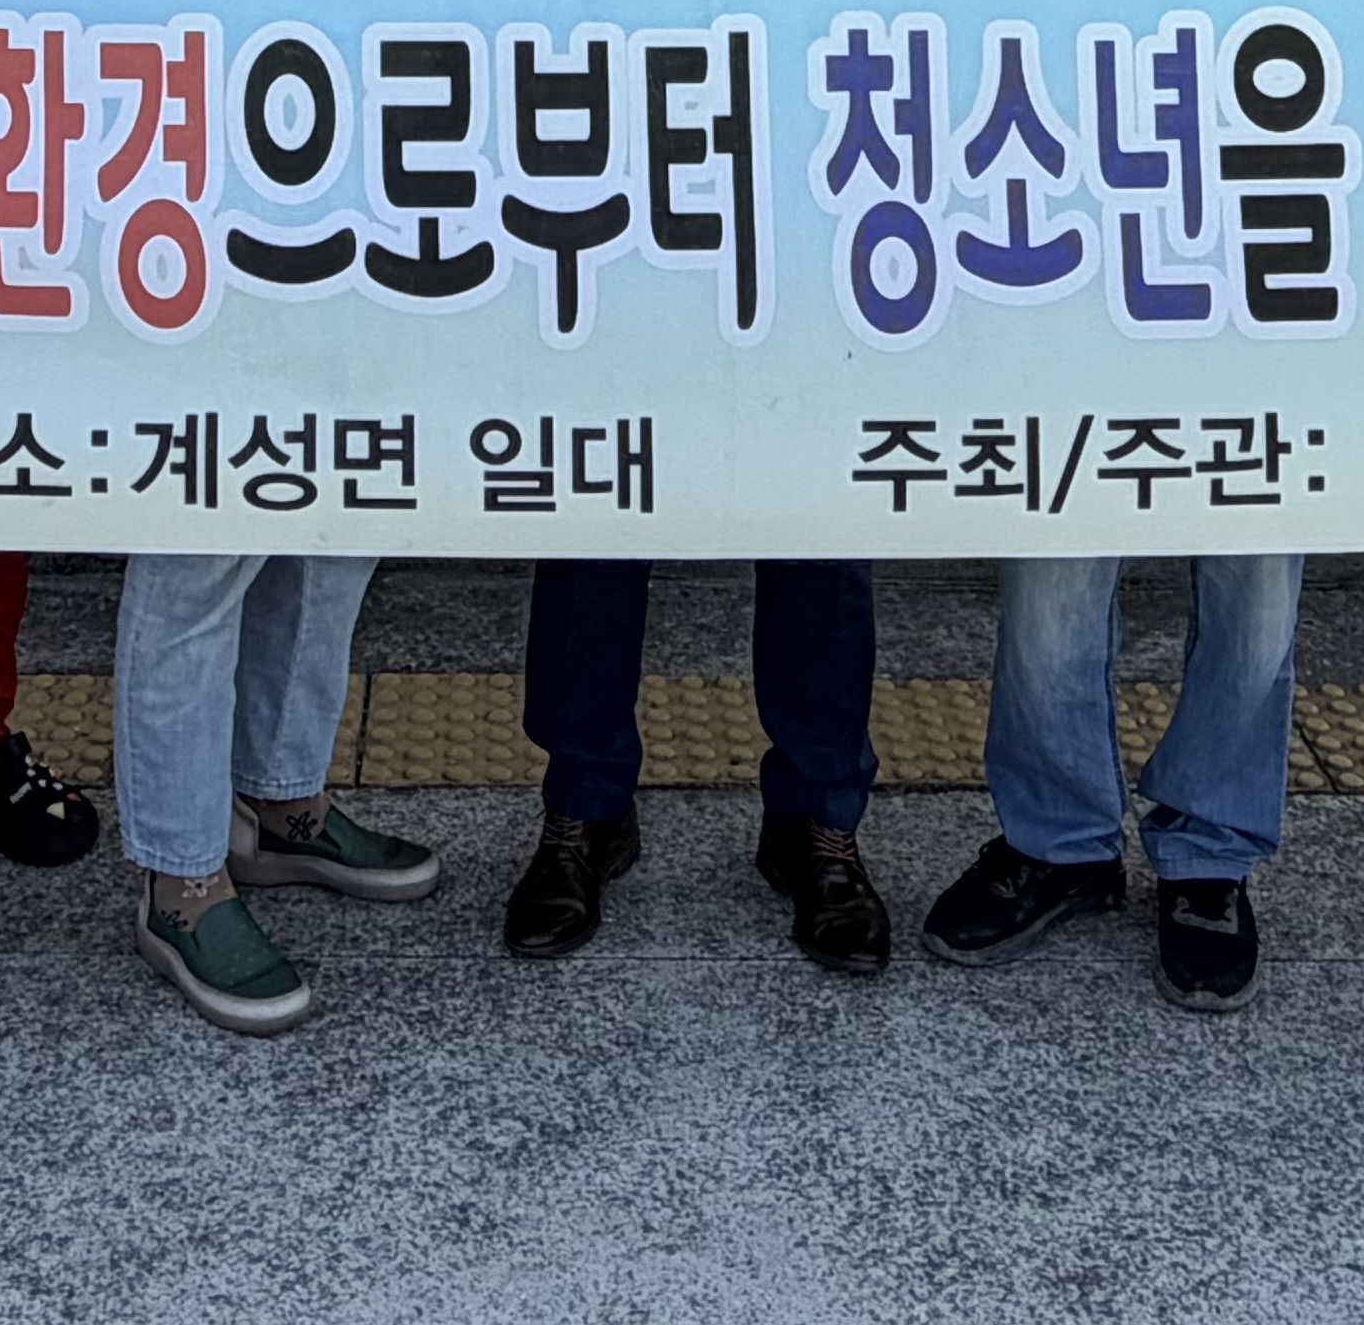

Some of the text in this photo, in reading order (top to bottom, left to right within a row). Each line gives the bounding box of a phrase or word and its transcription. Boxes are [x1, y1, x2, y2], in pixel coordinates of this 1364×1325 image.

[825, 23, 1347, 335] 청소년을
[470, 416, 656, 514] 일대
[850, 413, 1326, 515] 주최/주관:
